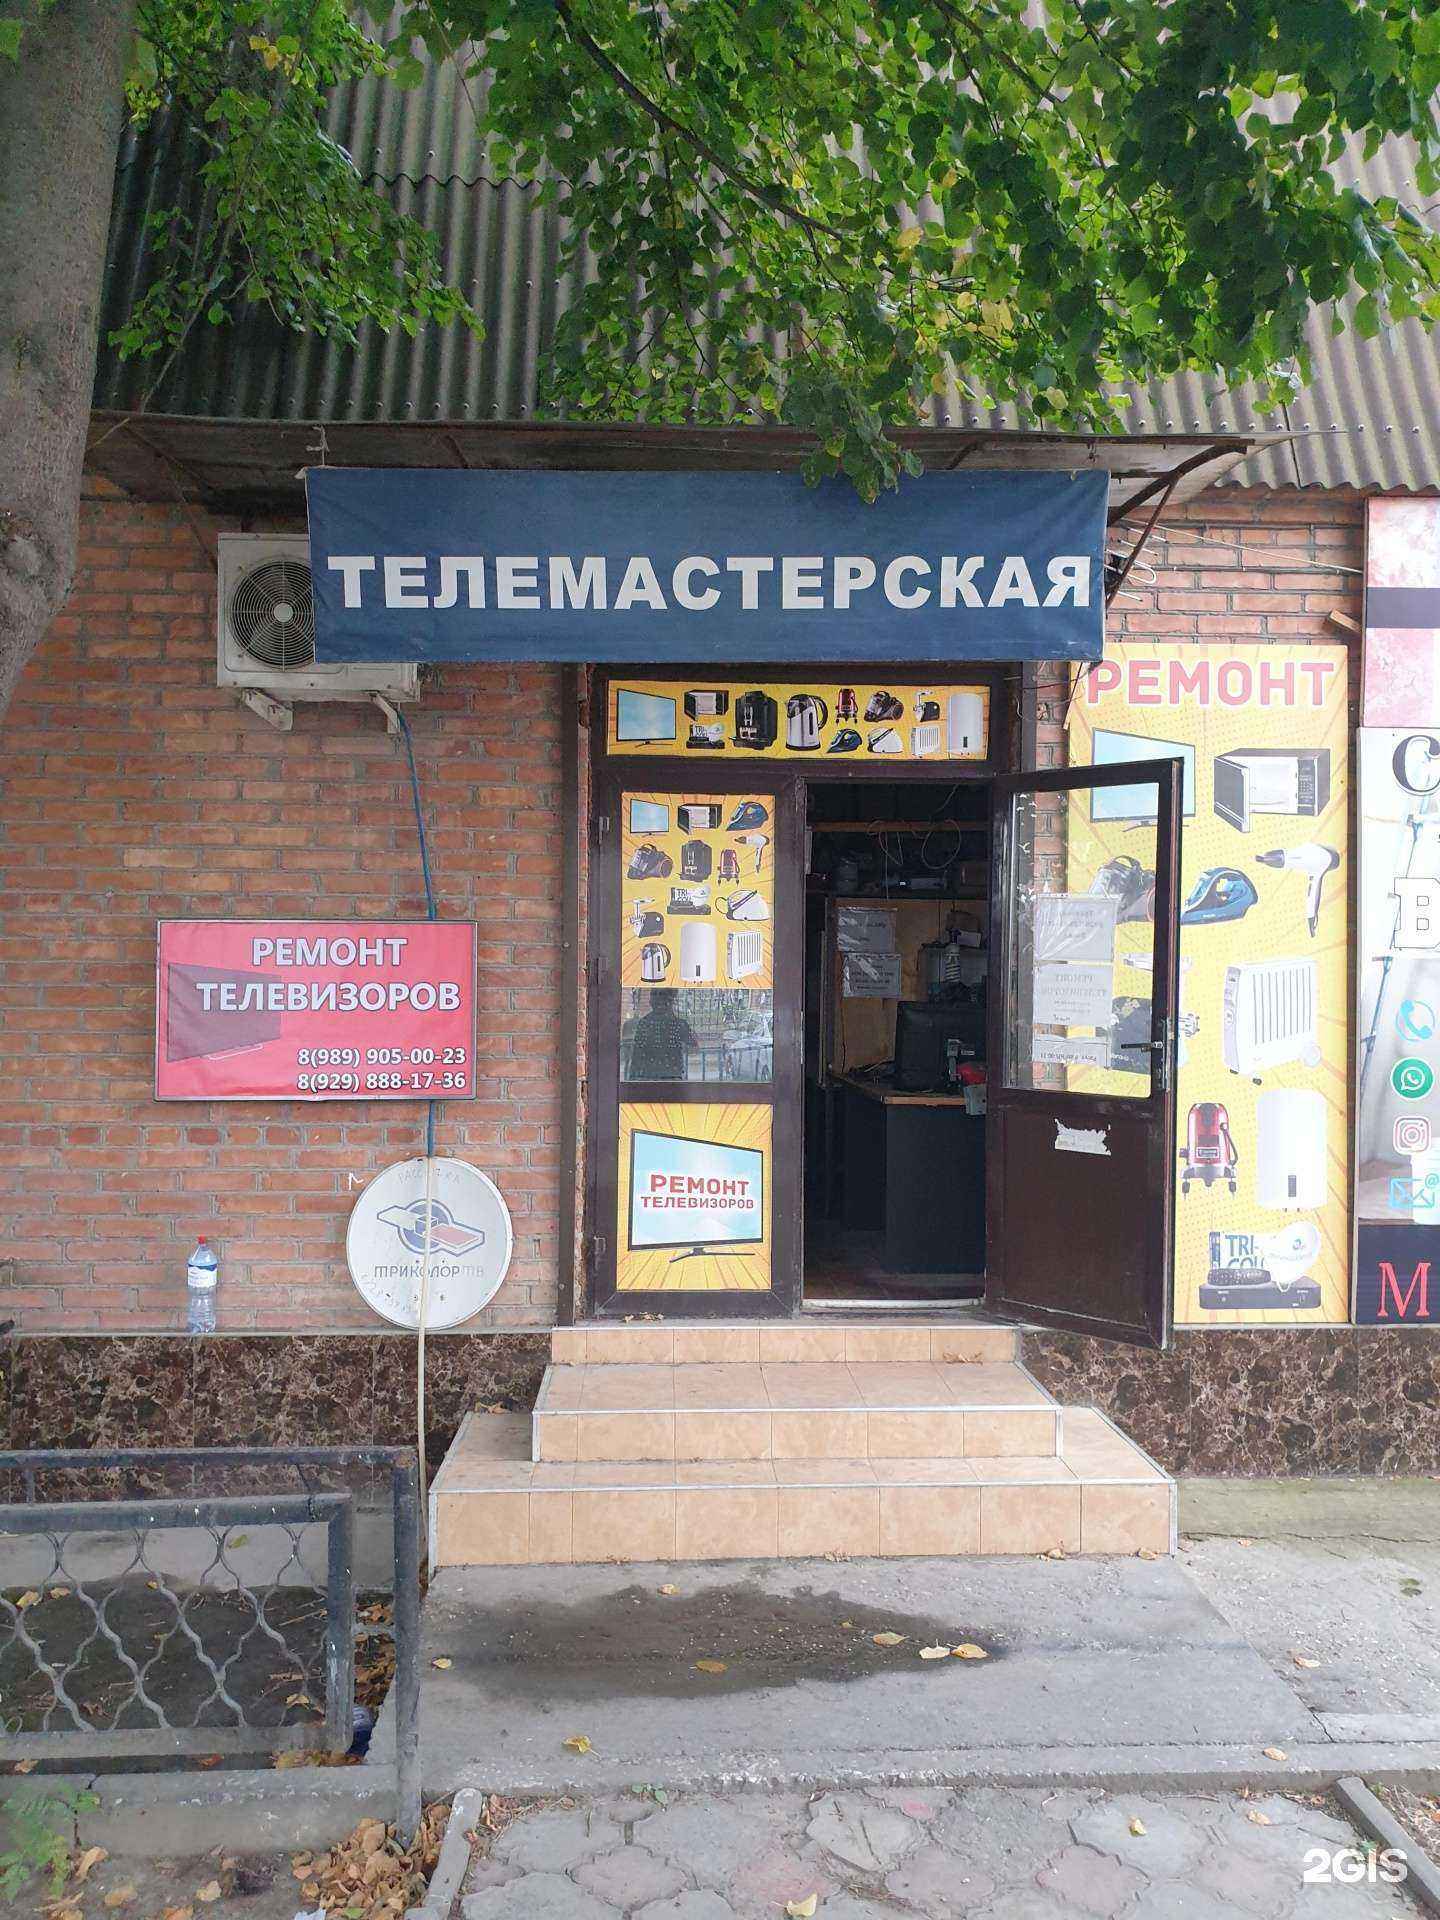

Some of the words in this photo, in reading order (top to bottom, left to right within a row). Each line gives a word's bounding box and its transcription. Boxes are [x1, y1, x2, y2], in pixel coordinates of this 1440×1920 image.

[327, 555, 1092, 611] ТЕЛЕМАСТЕРСКАЯ
[1087, 660, 1334, 706] РЕМОНТ
[251, 937, 408, 967] РЕМОНТ
[196, 981, 461, 1011] ТЕЛЕВИЗОРОВ
[297, 1048, 360, 1068] 8(989)
[366, 1048, 466, 1065] 905-00-23
[297, 1073, 360, 1092] 8(929)
[366, 1072, 466, 1090] 888-17-36
[650, 1174, 749, 1196] РЕМОНТ
[640, 1196, 754, 1209] ТЕЛЕВИЗОРОВ
